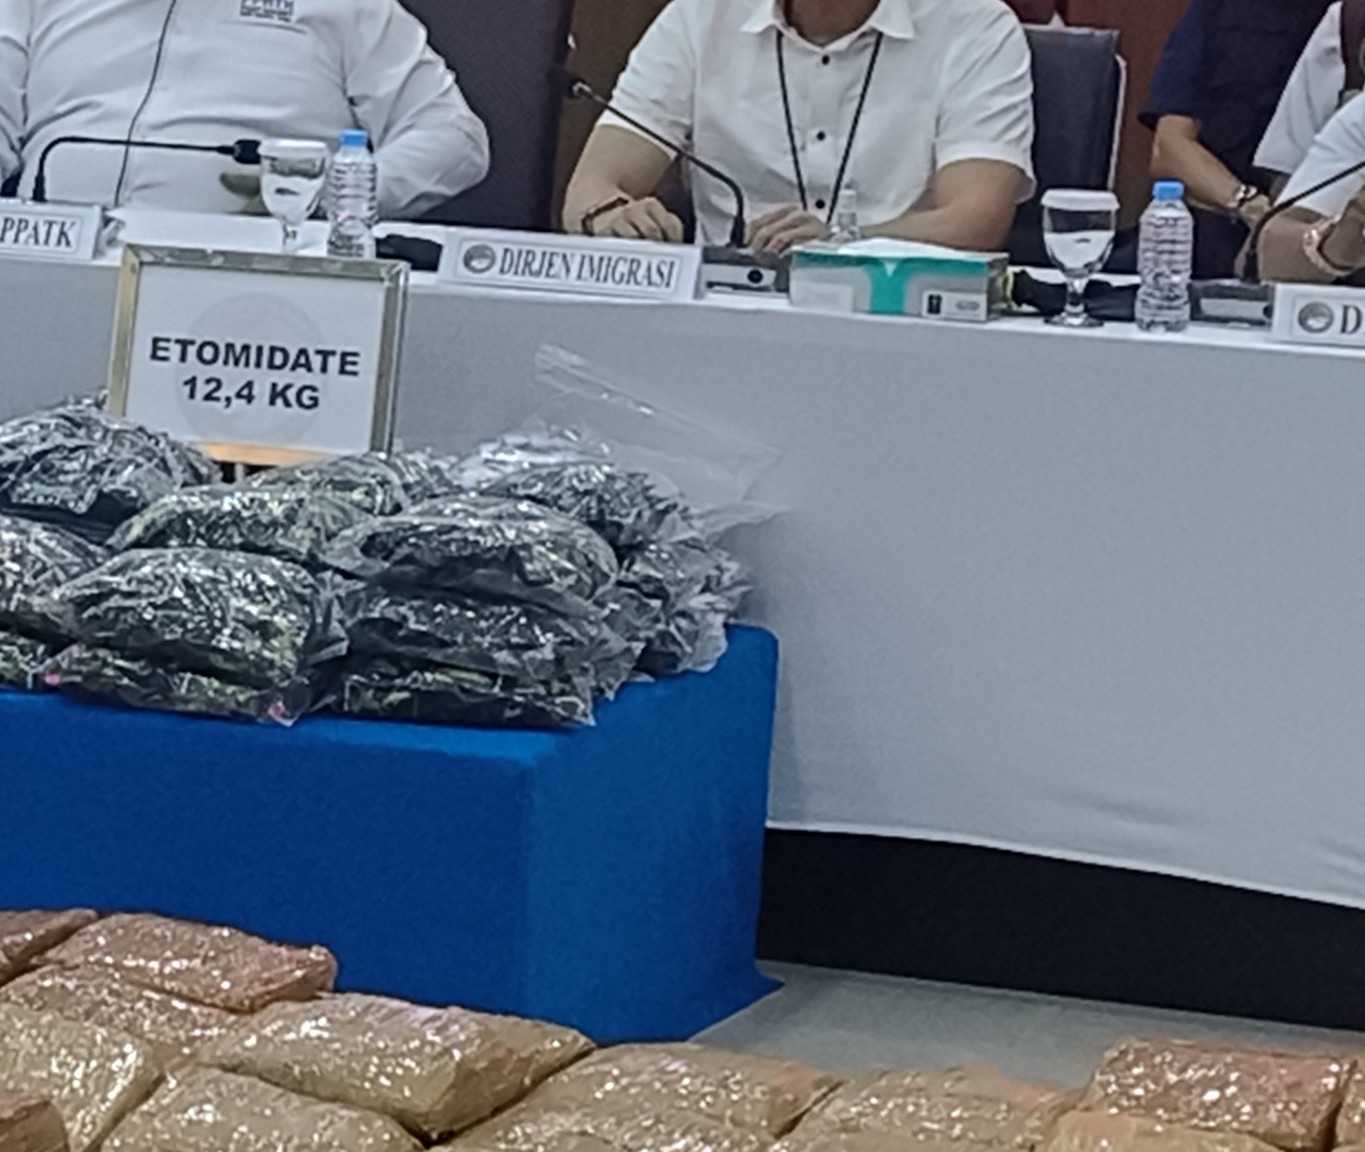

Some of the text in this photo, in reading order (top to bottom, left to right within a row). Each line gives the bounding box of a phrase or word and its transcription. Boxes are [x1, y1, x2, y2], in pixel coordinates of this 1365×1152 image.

[0, 216, 74, 248] PPATK
[498, 248, 677, 289] DIRJEN IMIGRASI
[1340, 304, 1365, 336] D
[149, 336, 361, 377] ETOMIDATE
[183, 375, 320, 410] 12,4 KG
